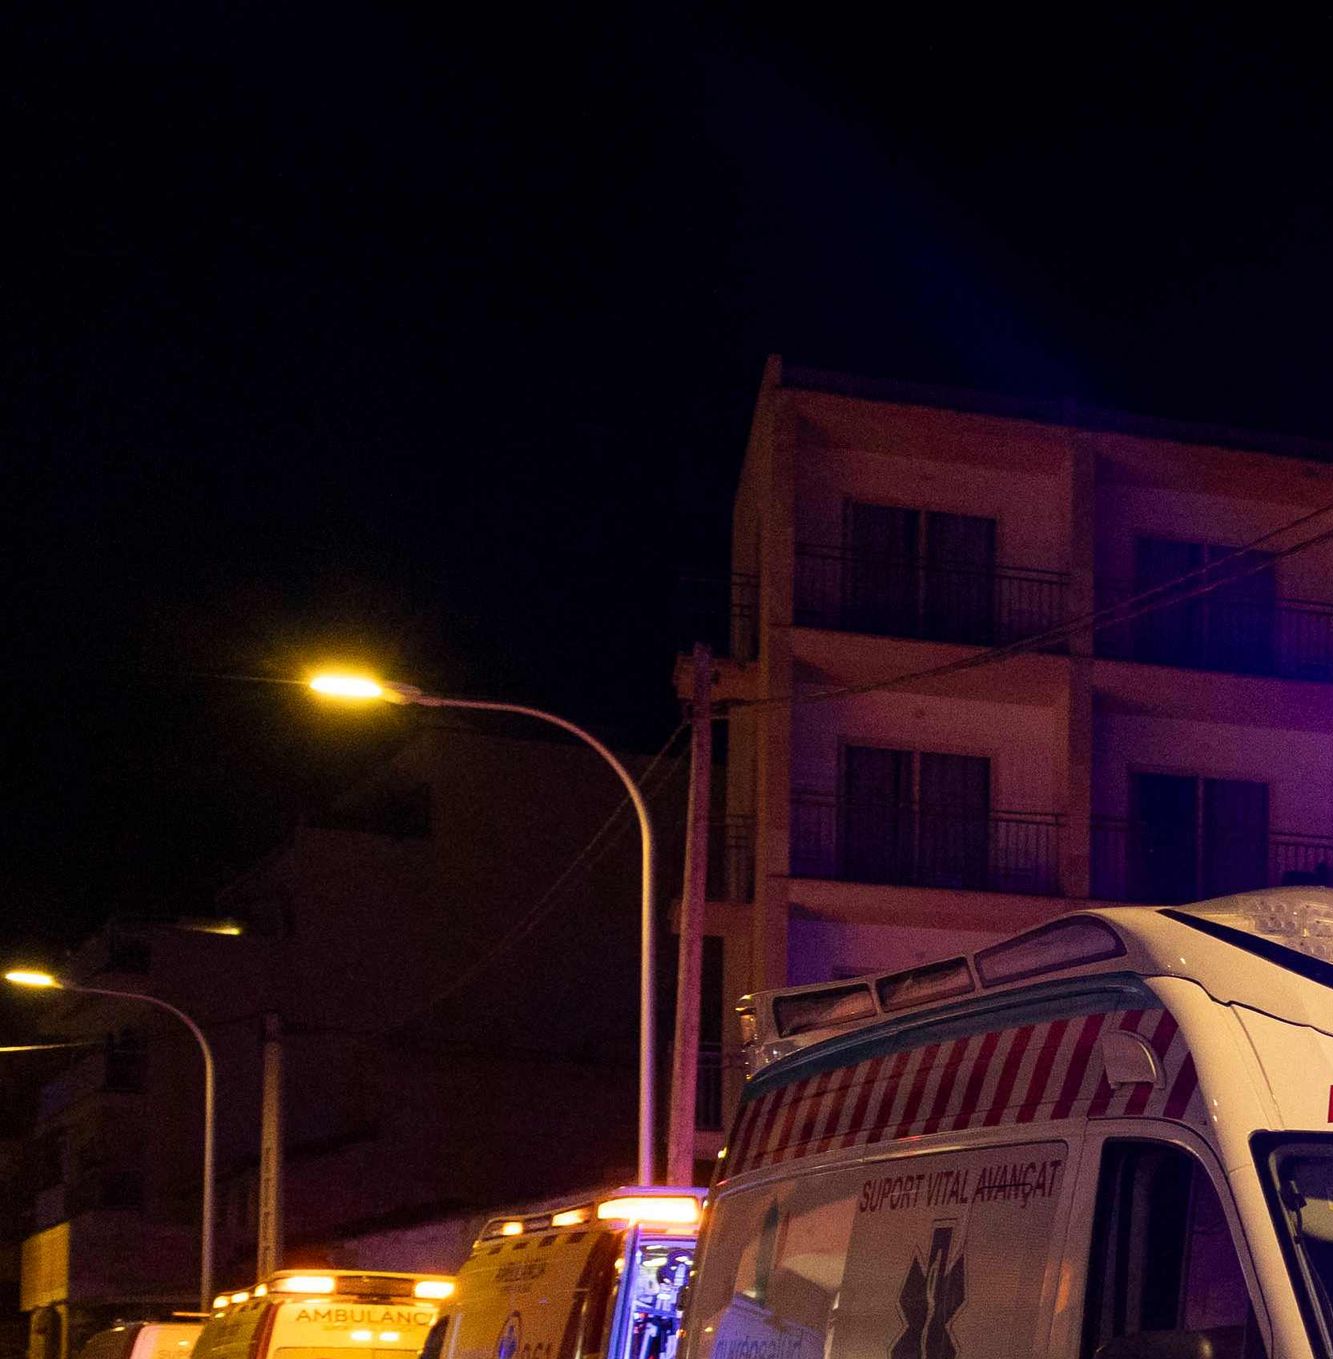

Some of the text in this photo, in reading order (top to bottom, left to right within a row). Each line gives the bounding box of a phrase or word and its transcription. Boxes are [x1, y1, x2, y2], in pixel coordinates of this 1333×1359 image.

[859, 1159, 1064, 1213] SUPORT VITAL AVANÇAT
[296, 1309, 438, 1326] AMBULANC
